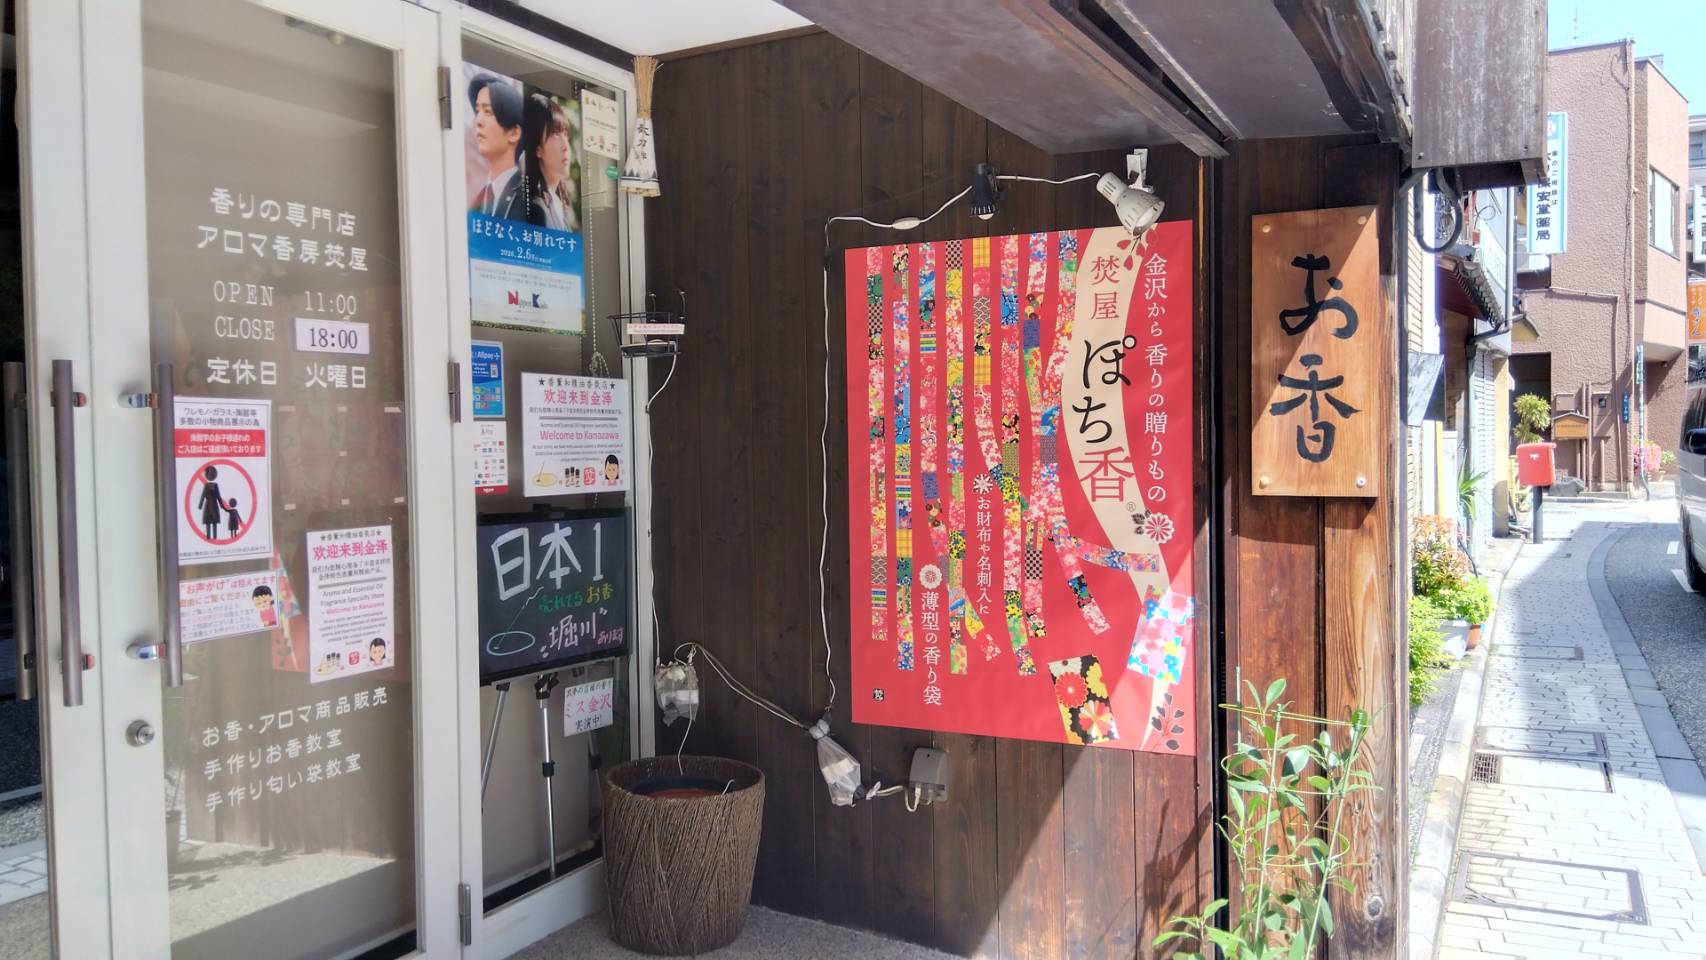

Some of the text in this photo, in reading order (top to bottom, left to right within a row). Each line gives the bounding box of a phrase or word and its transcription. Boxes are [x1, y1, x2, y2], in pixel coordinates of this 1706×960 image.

[210, 187, 356, 236] 香りの専門店
[472, 218, 577, 252] ほどなく、お別れです
[197, 225, 368, 271] アロマ香房焚屋
[213, 280, 357, 316] OPEN 11:00
[215, 316, 358, 349] CLOSE 18:00
[206, 357, 366, 389] 定休日 火曜日
[1072, 255, 1137, 502] 焚屋 ぽち香
[1269, 254, 1363, 463] お香
[544, 389, 613, 406] 欢迎来到金泽
[540, 431, 619, 441] Welcome to Kanazawa
[313, 539, 388, 561] 欢迎来到金泽
[976, 496, 993, 615] お財布や名刺入に
[921, 591, 942, 706] 薄型の香り袋
[202, 686, 388, 747] お香・アロマ商品販売
[204, 728, 343, 781] 手作りお香教室
[204, 753, 361, 813] 手作り匂い袋教室
